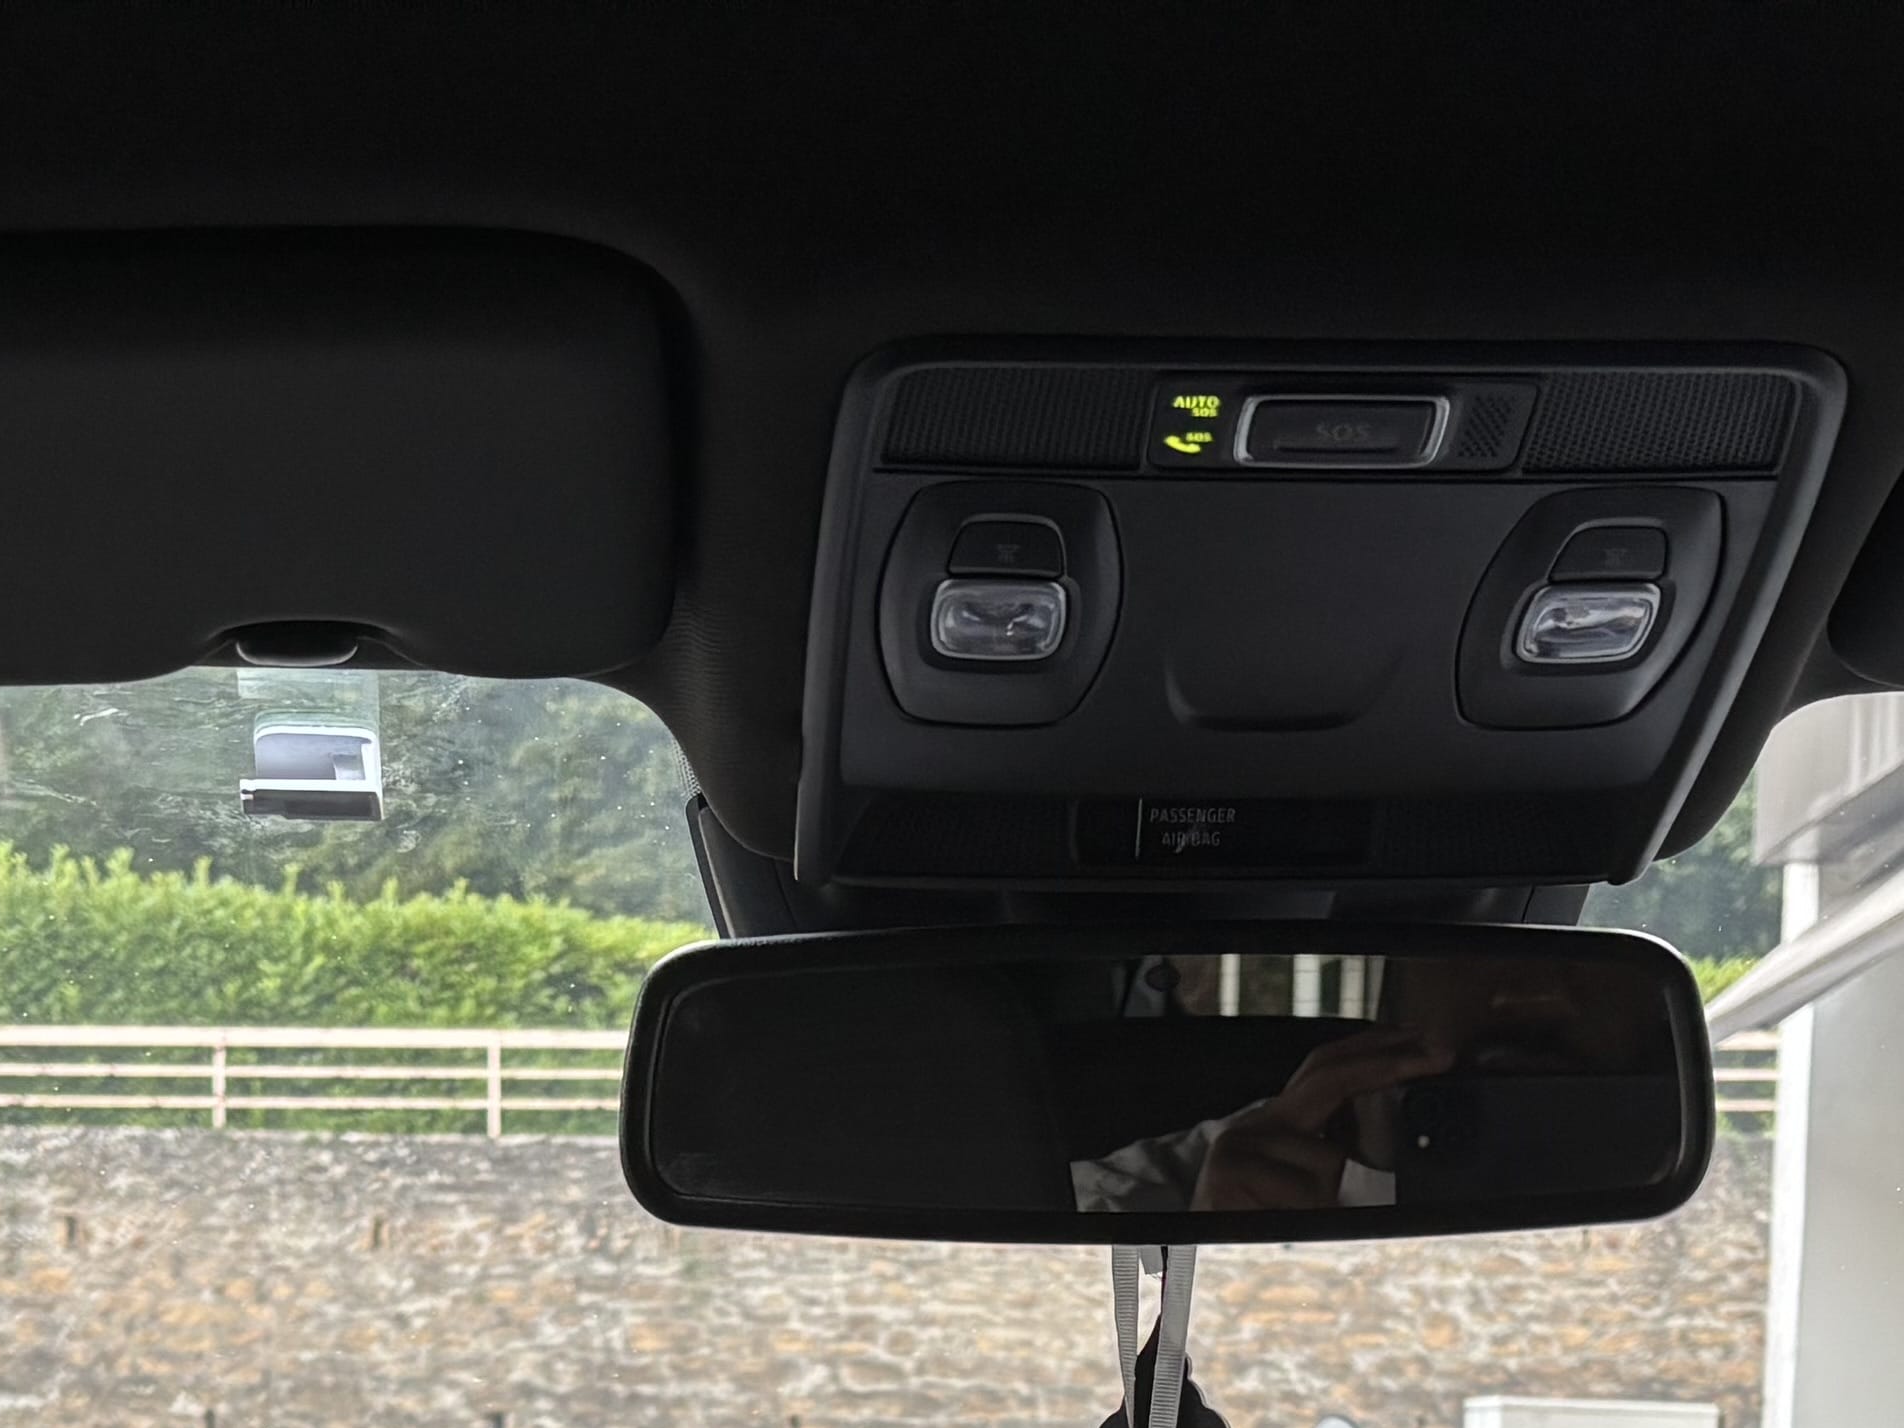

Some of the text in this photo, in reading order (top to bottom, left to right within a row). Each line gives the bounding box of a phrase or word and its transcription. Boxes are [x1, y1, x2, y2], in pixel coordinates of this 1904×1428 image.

[1173, 396, 1220, 409] AUTO
[1192, 407, 1218, 418] SOS
[1186, 432, 1212, 443] SOS
[1317, 423, 1371, 441] SOS
[1150, 808, 1236, 823] PASSENGER
[1162, 831, 1220, 847] AIRBAG
